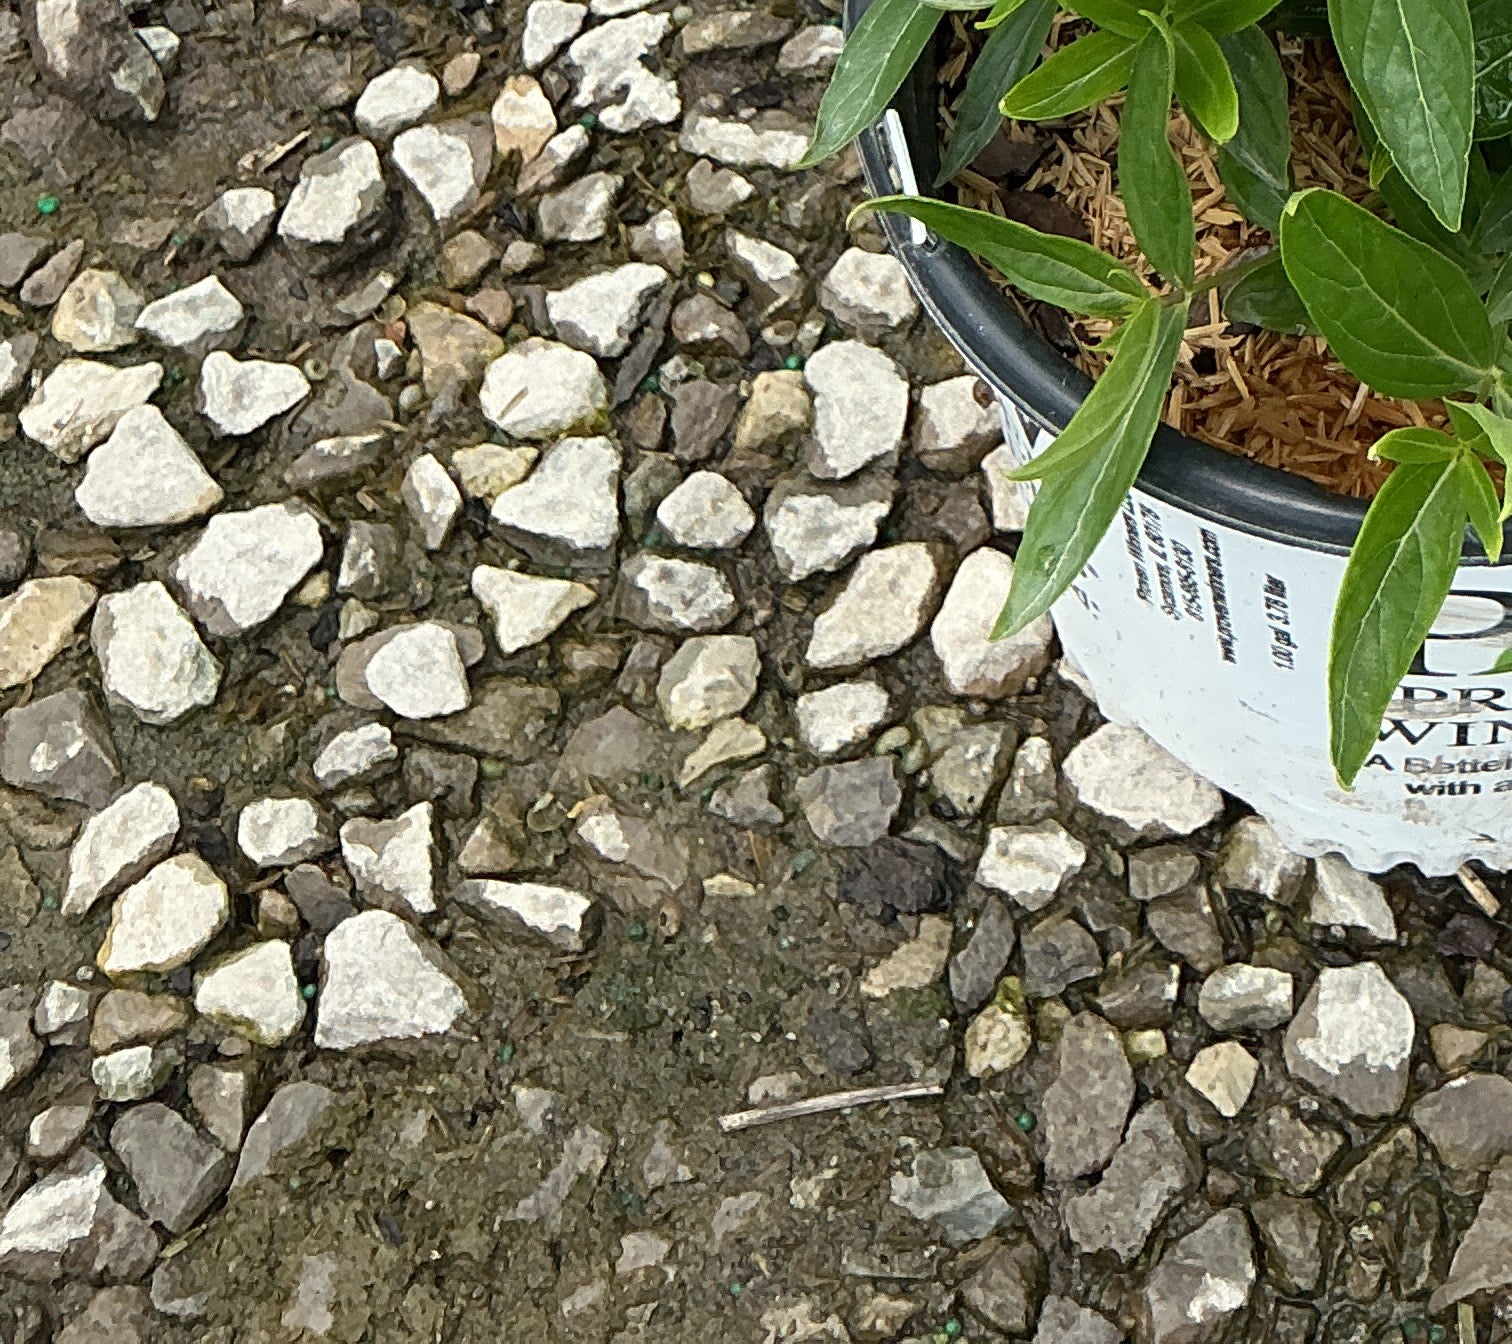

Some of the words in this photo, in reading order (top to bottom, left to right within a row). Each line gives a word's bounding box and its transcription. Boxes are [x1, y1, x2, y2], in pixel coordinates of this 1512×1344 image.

[1267, 623, 1299, 649] gal
[1269, 642, 1296, 671] 1.00
[1363, 752, 1395, 772] A
[1404, 780, 1482, 797] with
